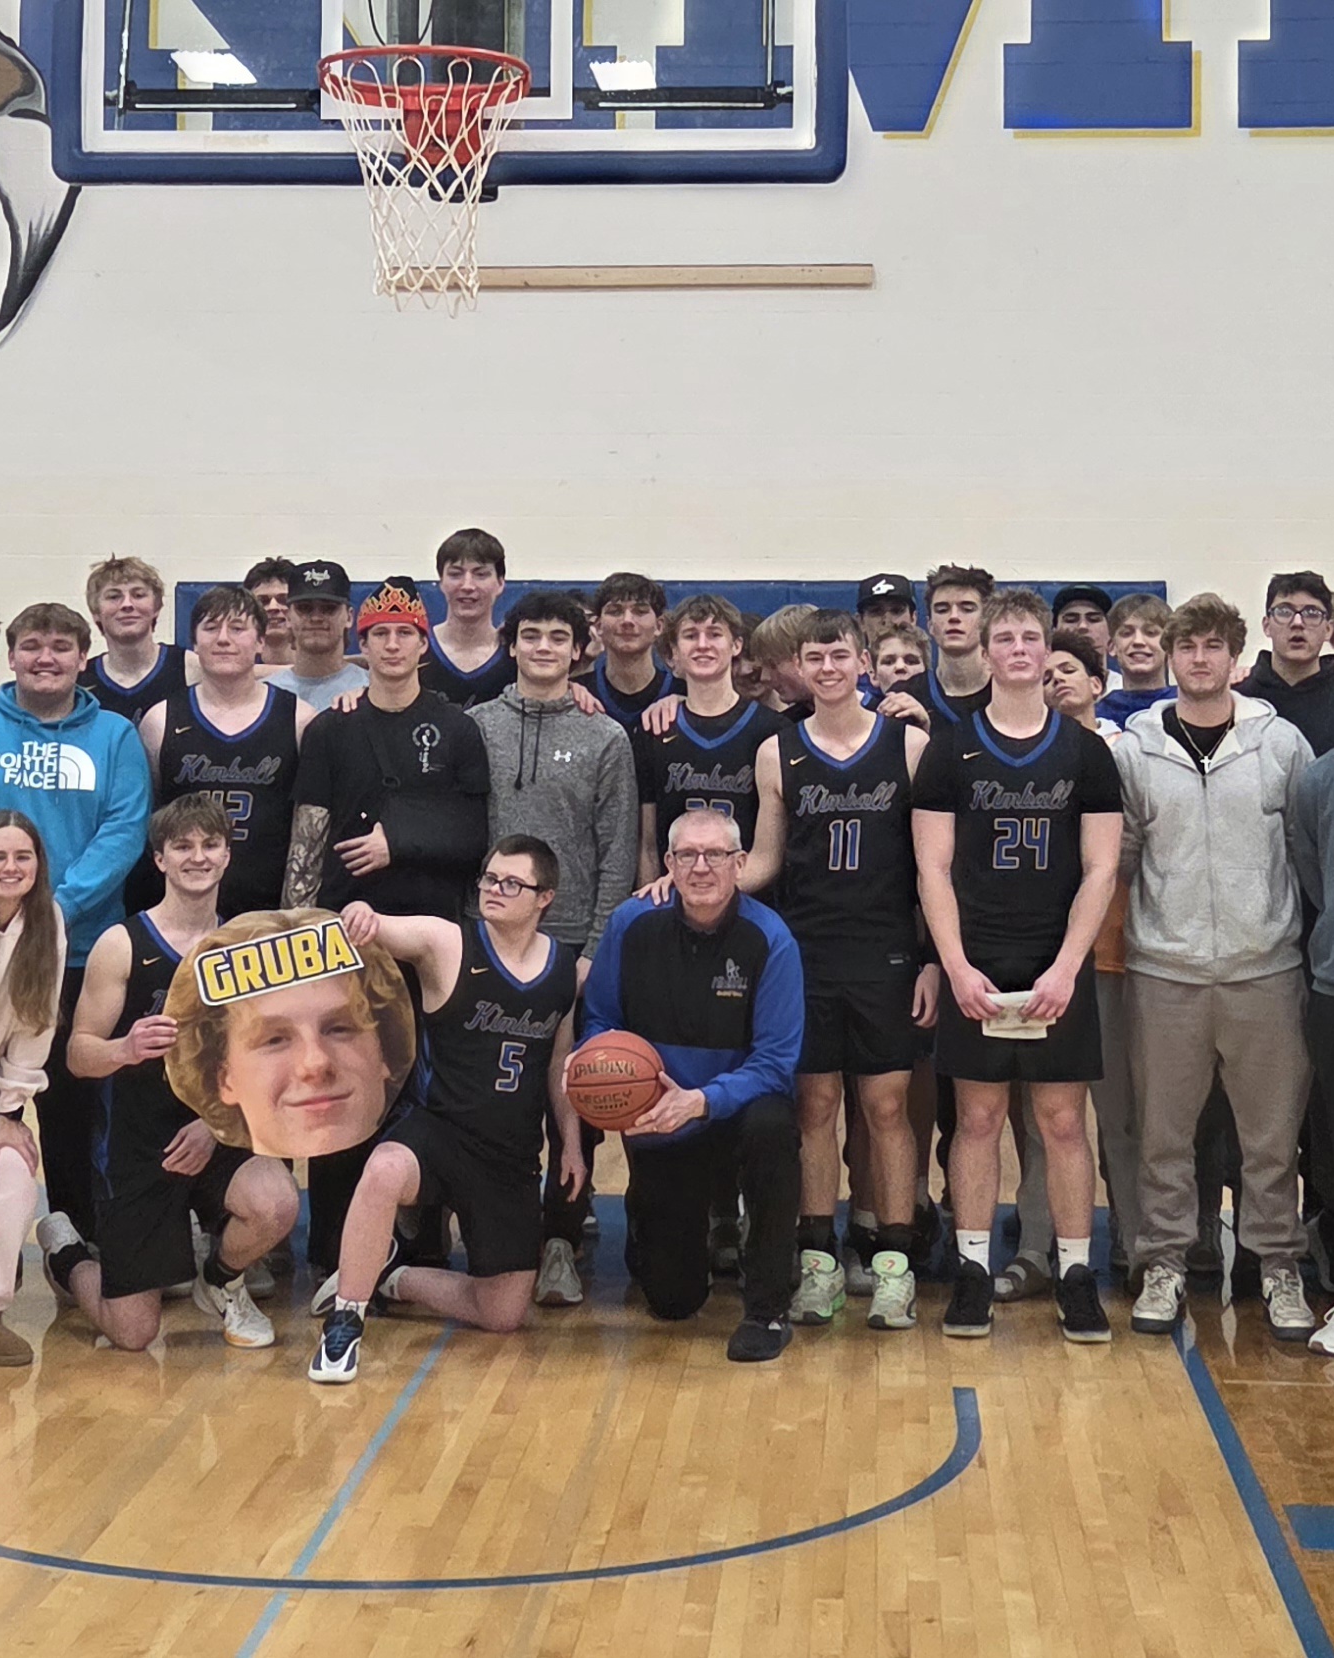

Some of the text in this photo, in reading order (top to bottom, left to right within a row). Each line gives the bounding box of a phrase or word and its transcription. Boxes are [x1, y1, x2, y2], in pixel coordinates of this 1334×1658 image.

[23, 741, 58, 757] THE
[4, 767, 57, 790] FACE
[173, 753, 282, 785] Kimball
[665, 762, 754, 794] Kimball
[796, 781, 897, 817] Kimball
[969, 779, 1075, 811] Kimball
[198, 790, 253, 840] 2
[828, 819, 861, 870] 11
[993, 818, 1050, 870] 24
[200, 923, 357, 1001] GRUBA
[495, 1041, 527, 1092] 5
